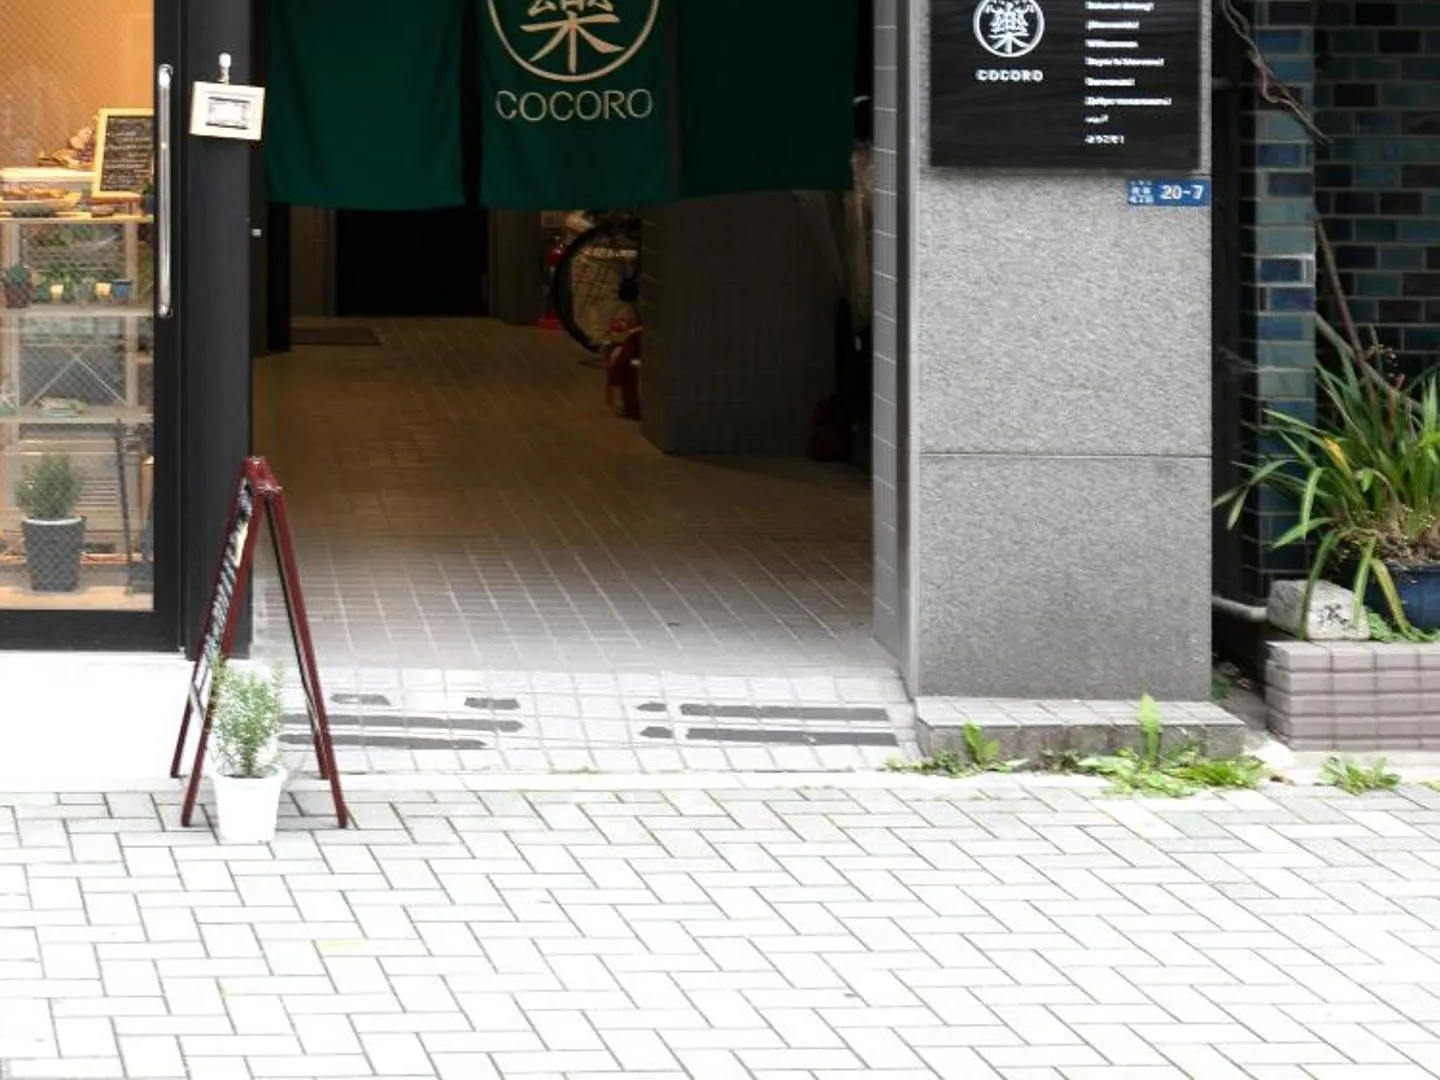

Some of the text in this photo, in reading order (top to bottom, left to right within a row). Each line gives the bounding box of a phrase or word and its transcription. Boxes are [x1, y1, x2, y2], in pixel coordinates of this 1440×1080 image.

[975, 69, 1044, 82] COCORO
[496, 88, 654, 122] COCORO
[1159, 184, 1205, 200] 20-7
